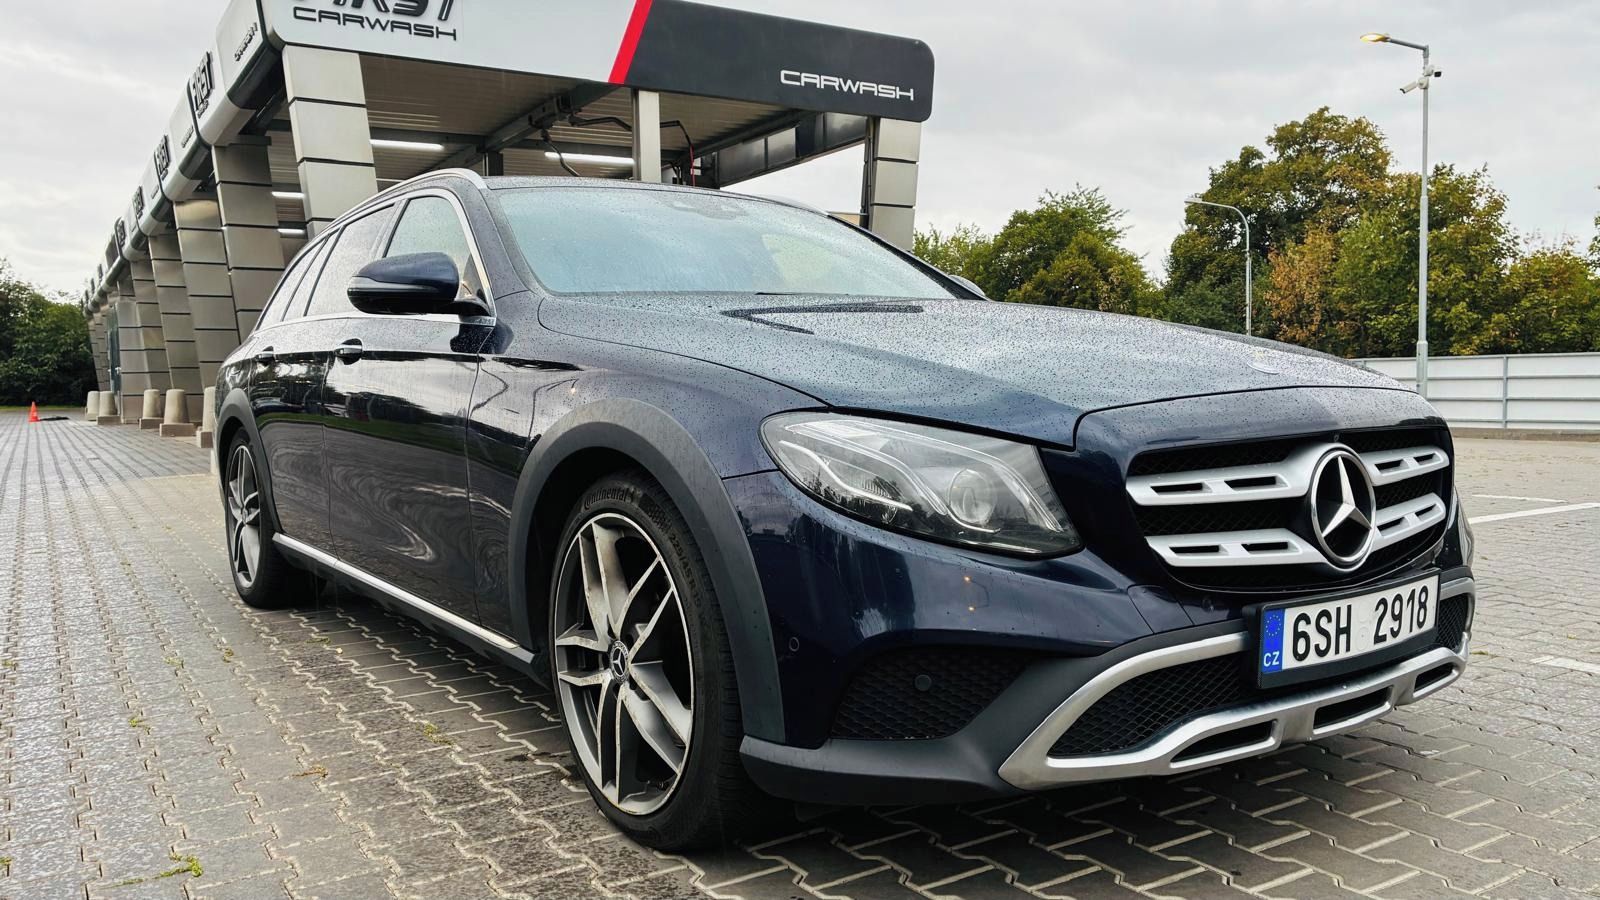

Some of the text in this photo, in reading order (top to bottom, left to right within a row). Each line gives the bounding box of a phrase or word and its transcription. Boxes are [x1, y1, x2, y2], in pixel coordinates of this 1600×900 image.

[293, 6, 457, 41] CARWASH
[780, 69, 914, 101] CARWASH
[1292, 585, 1429, 662] 6SH 2918
[1263, 651, 1280, 667] CZ
